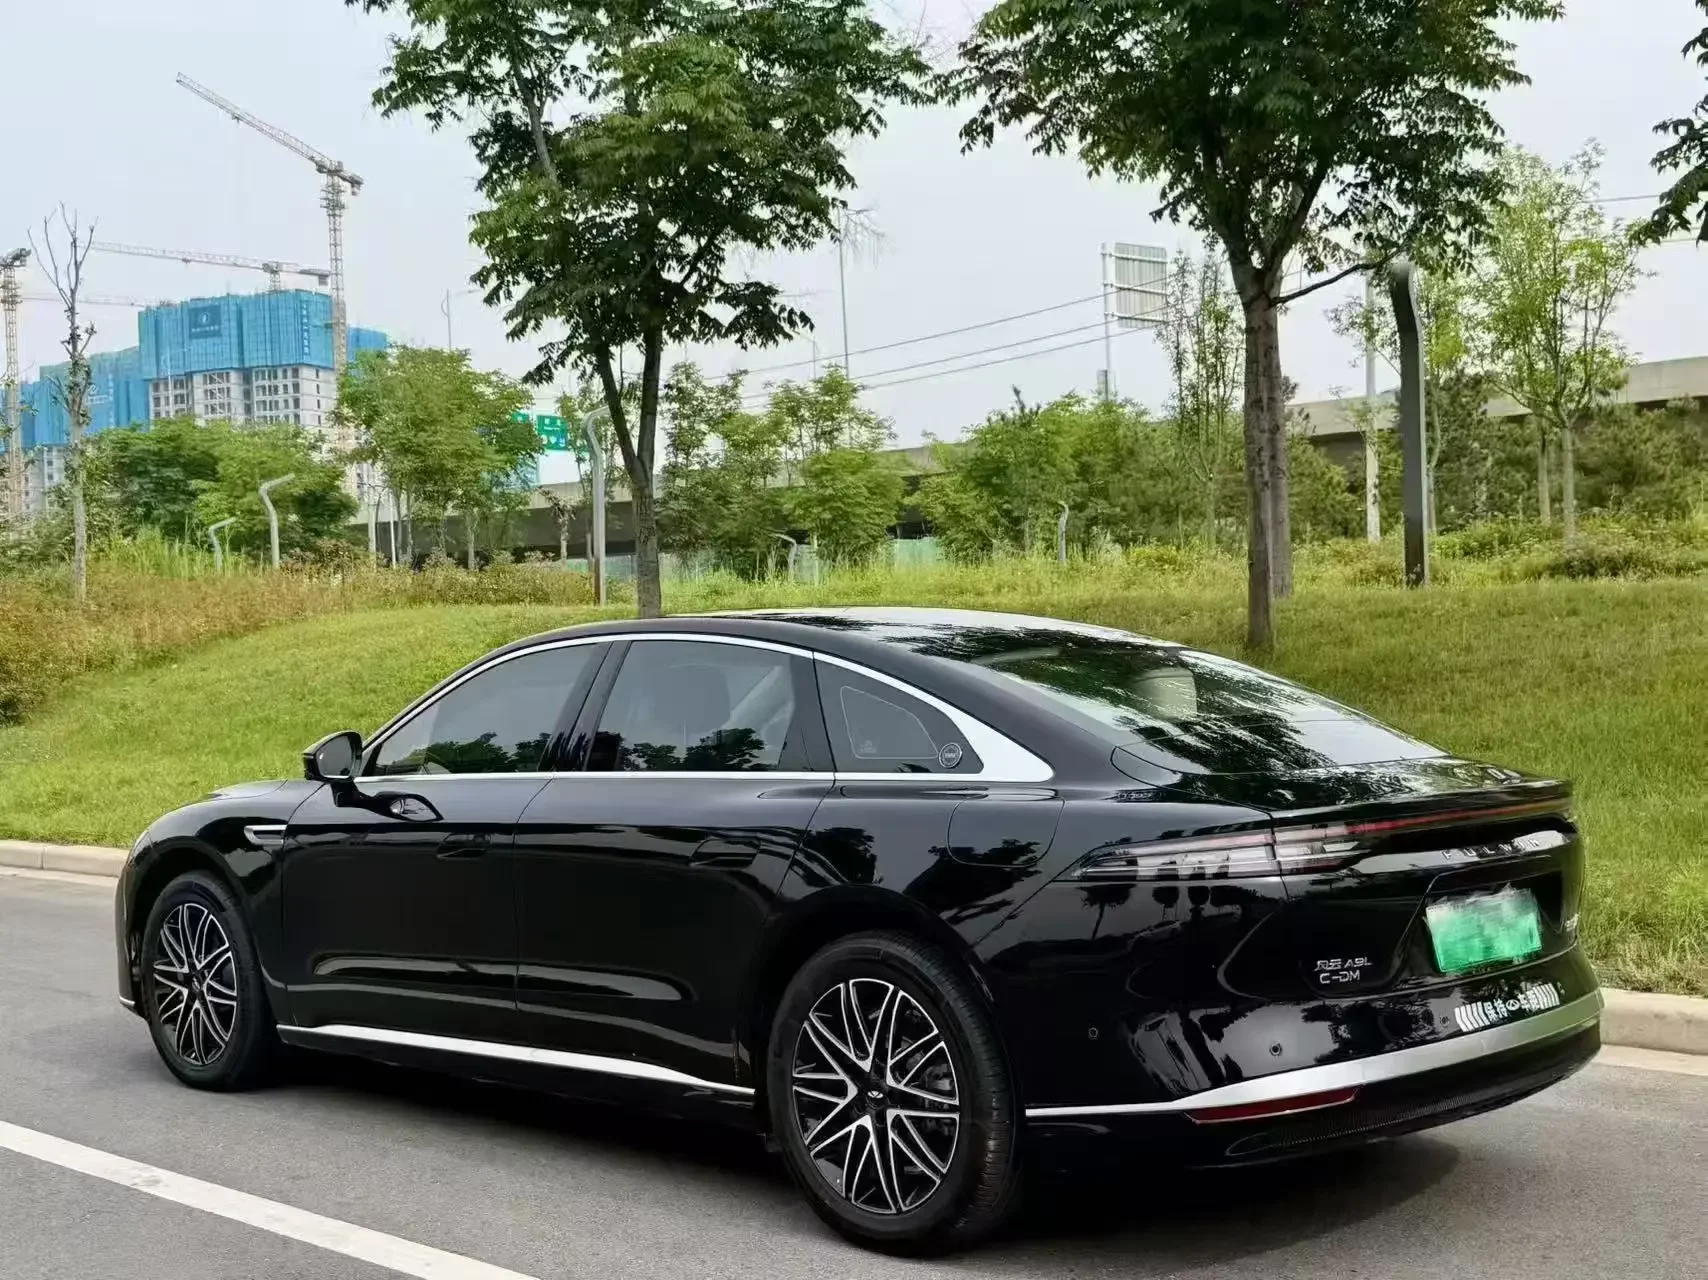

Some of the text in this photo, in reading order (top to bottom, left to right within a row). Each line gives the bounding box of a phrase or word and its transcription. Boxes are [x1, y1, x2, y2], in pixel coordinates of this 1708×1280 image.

[1441, 839, 1539, 859] FULWIN
[1319, 969, 1360, 984] C-DM
[1483, 998, 1508, 1022] 保持
